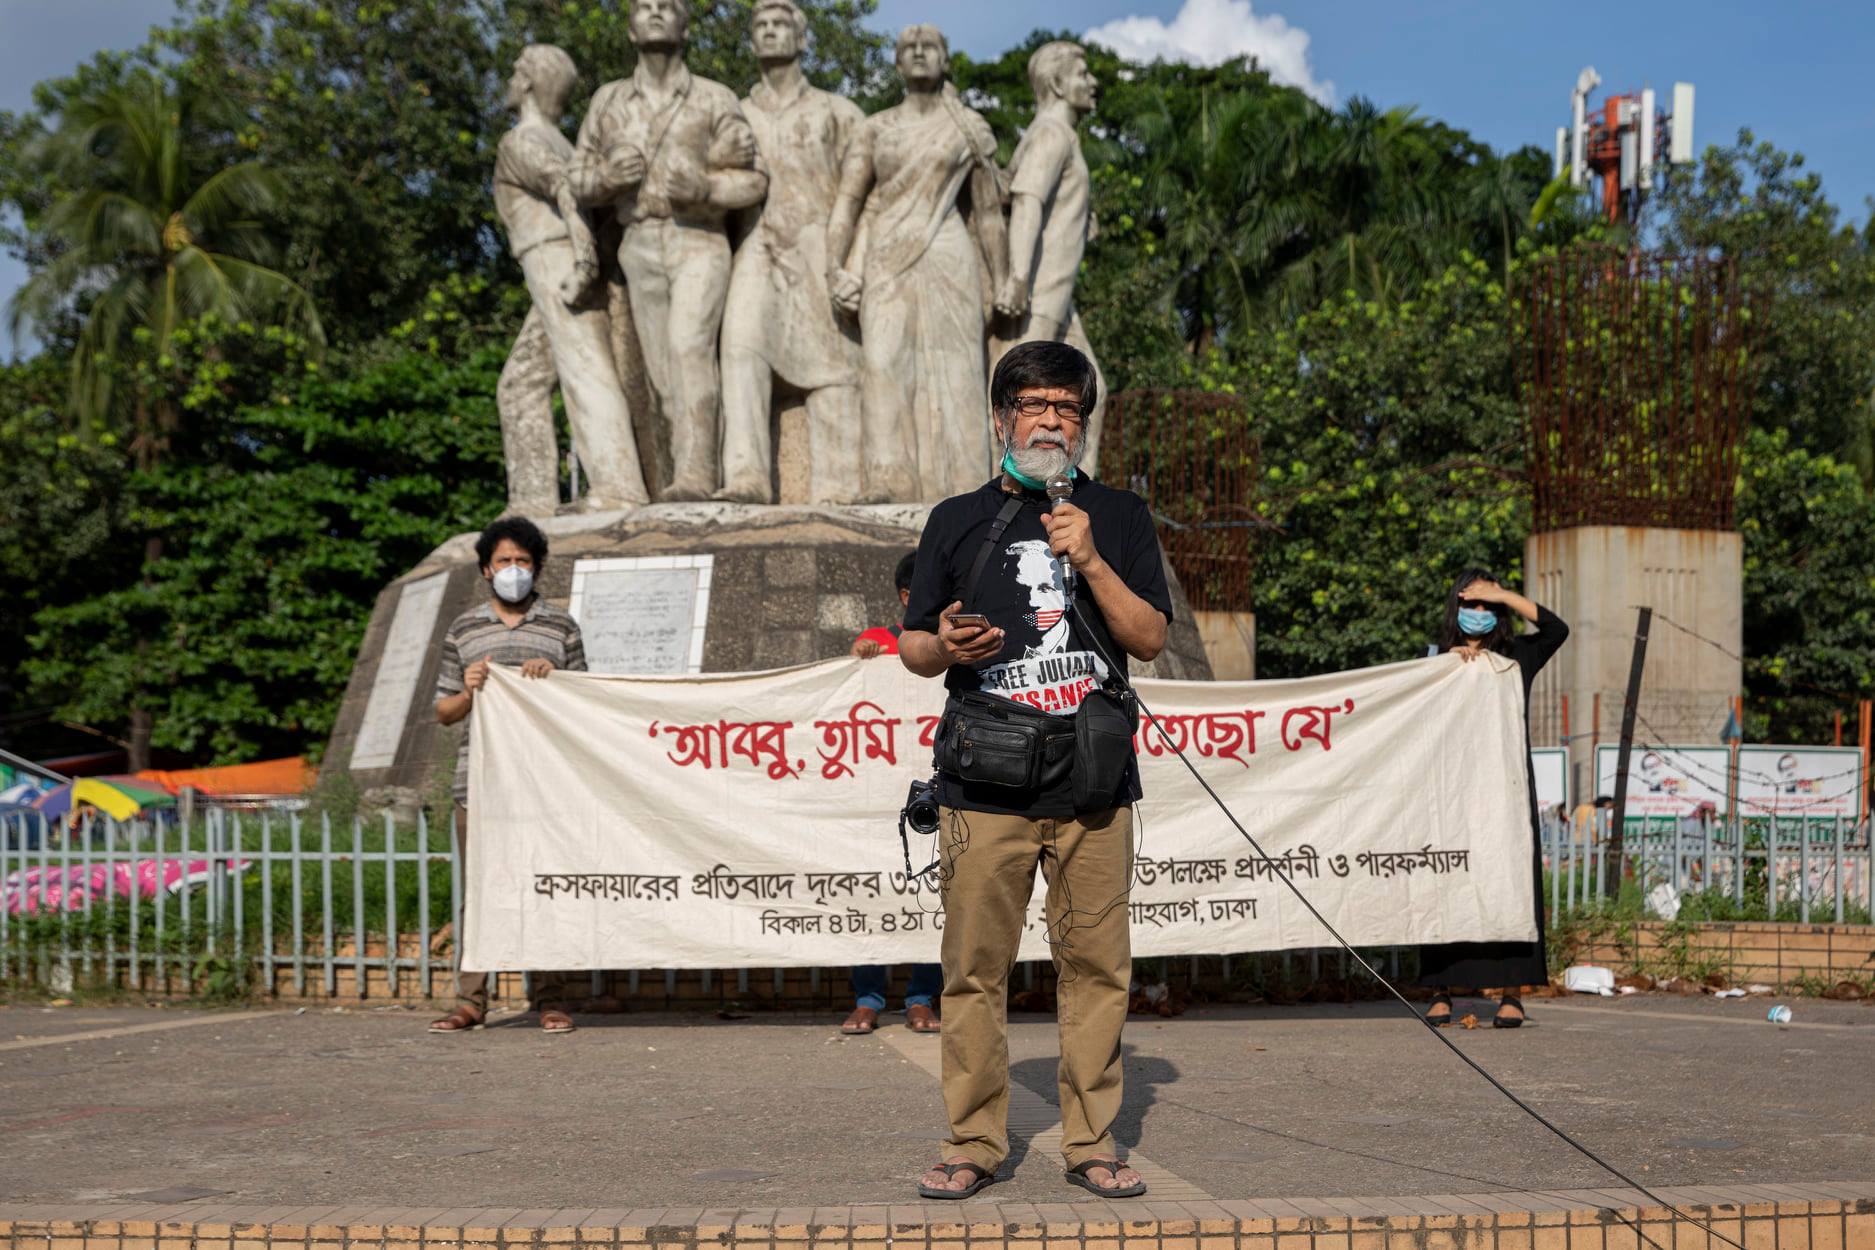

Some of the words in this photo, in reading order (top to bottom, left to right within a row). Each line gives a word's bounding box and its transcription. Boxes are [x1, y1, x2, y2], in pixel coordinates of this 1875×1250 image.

[987, 663, 1029, 690] FREE
[1037, 656, 1096, 685] JULIAN
[814, 701, 902, 780] তুমি
[534, 873, 681, 902] ক্রসফায়ারের
[691, 863, 796, 900] প্রতিবাদে
[804, 871, 882, 906] দৃকের
[1135, 854, 1228, 886] উপলক্ষে
[1234, 844, 1320, 882] প্রদর্শনী
[1328, 854, 1350, 878] ও
[760, 909, 823, 935] বিকাল
[1208, 898, 1258, 921] ঢাকা
